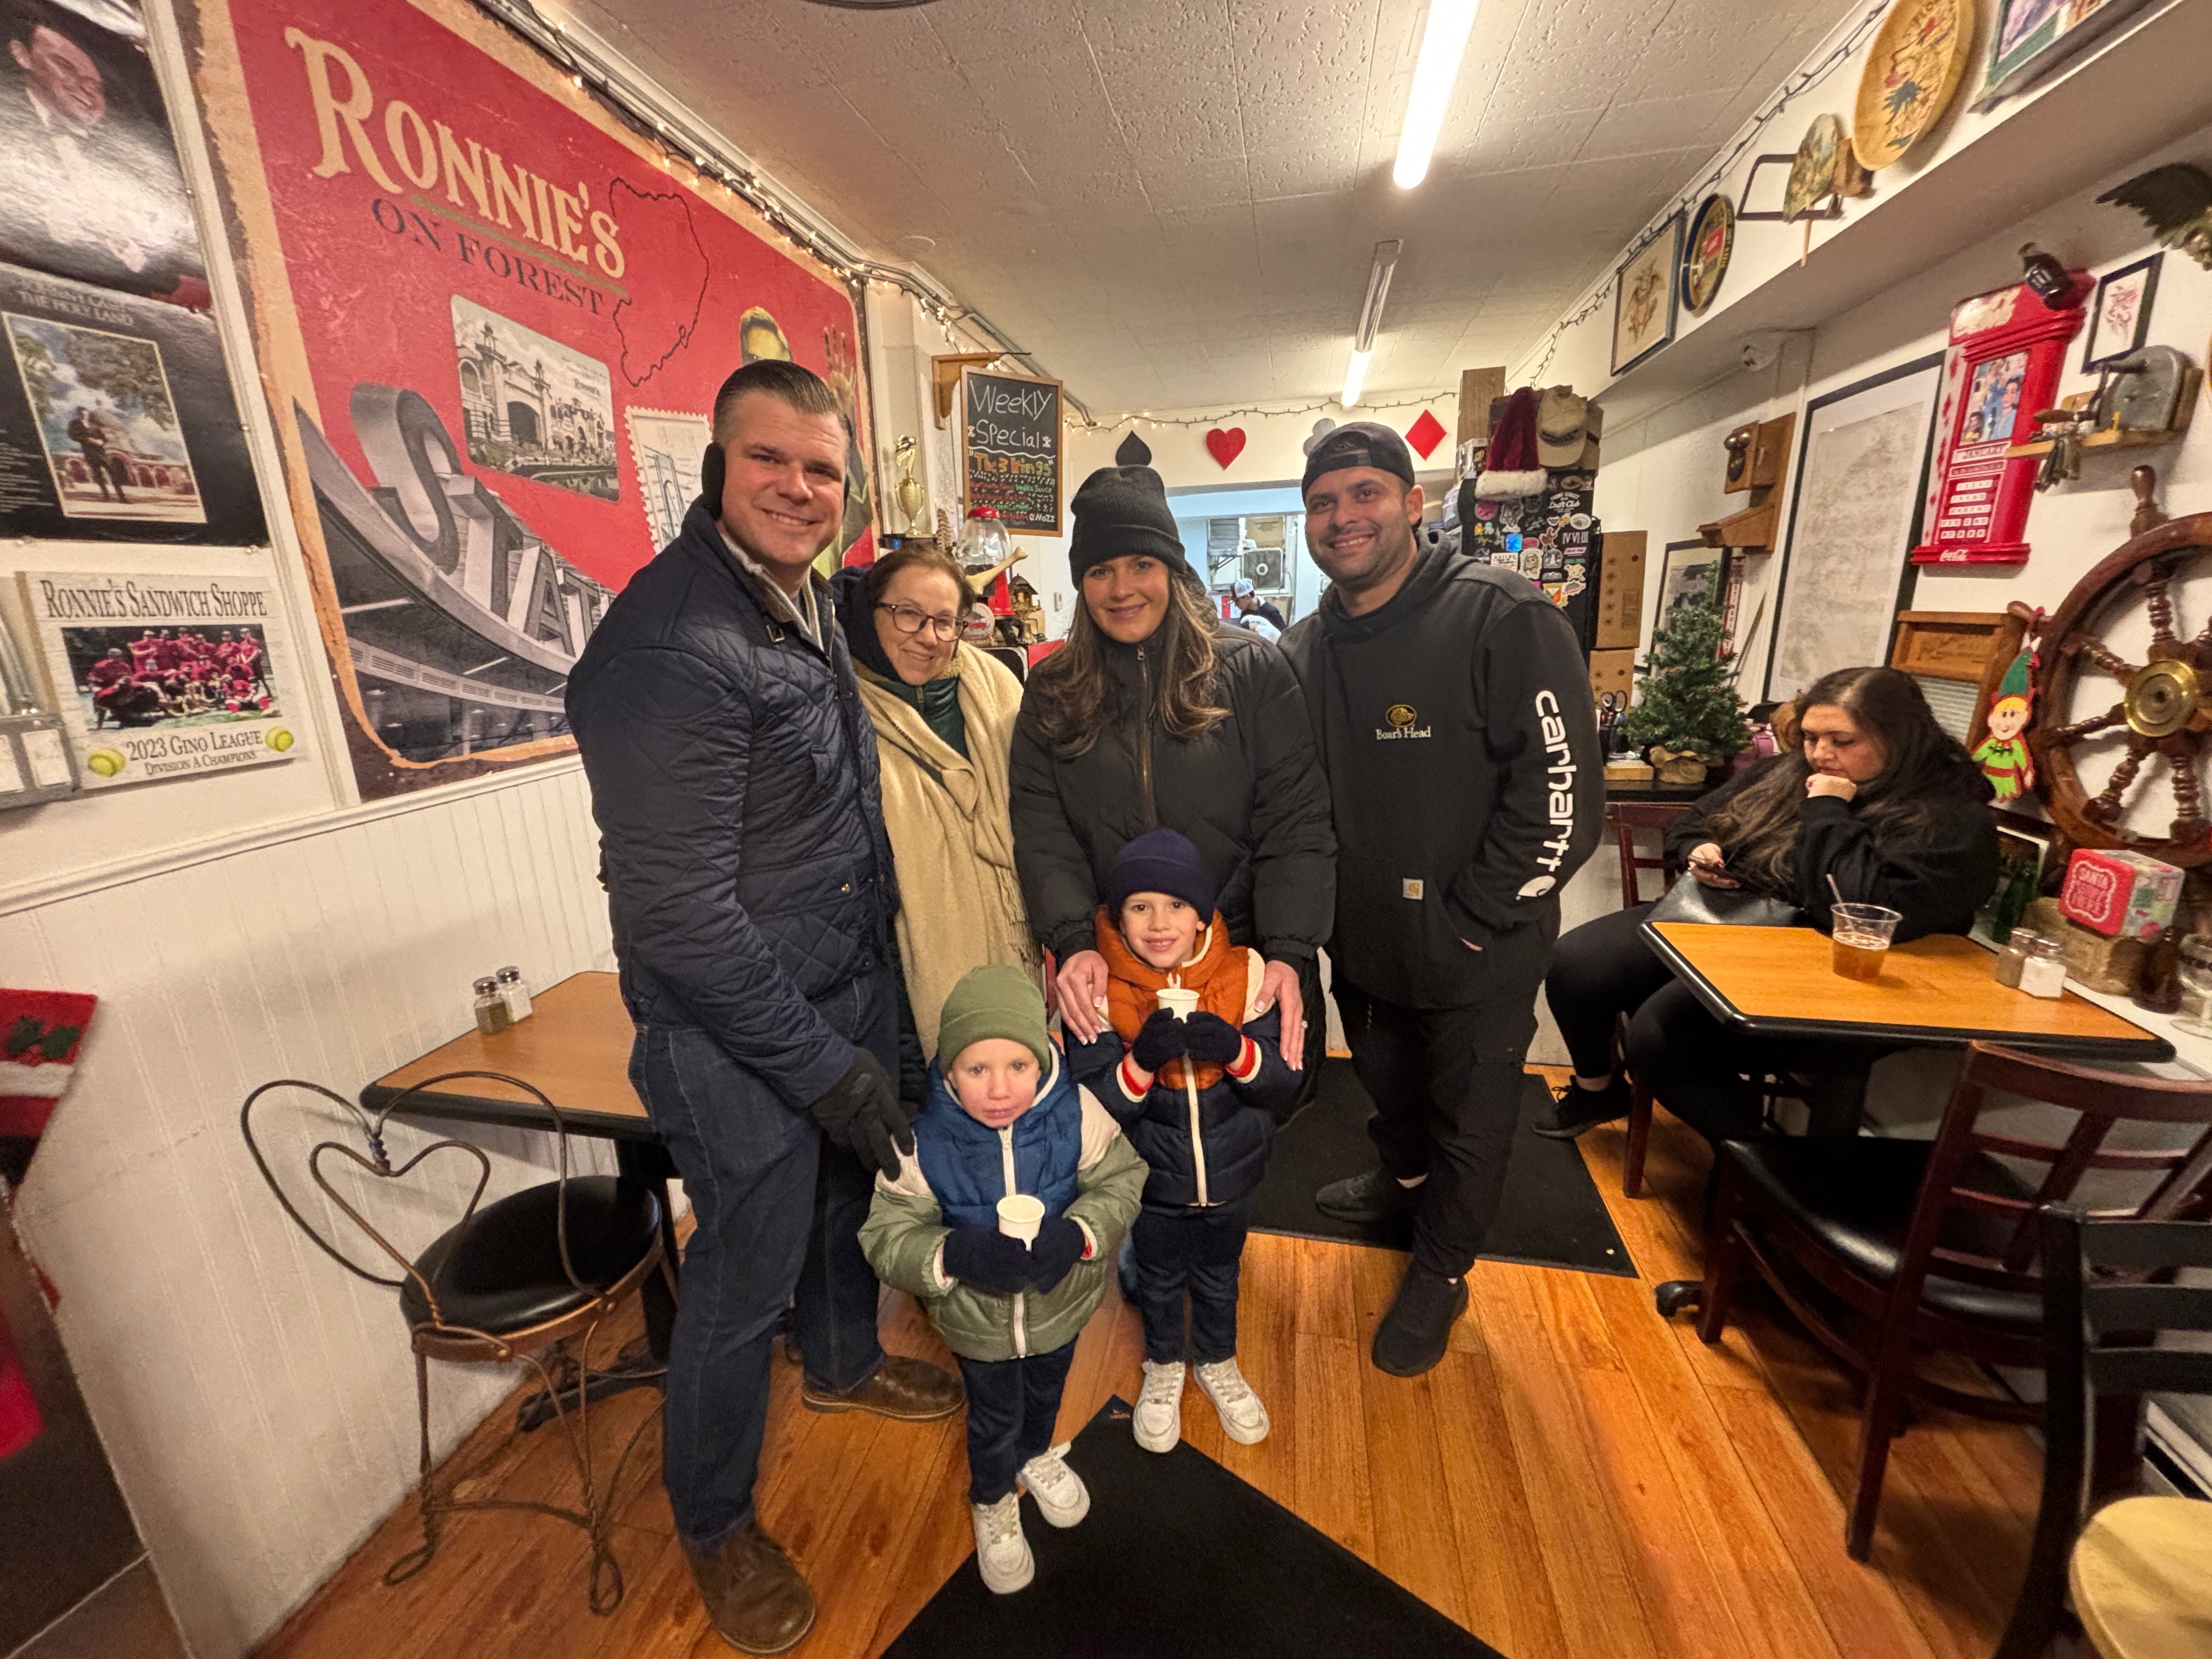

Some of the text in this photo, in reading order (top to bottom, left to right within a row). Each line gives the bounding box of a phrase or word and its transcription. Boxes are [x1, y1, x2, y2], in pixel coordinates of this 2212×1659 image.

[284, 26, 625, 278] RONNIE'S
[371, 198, 607, 315] ON FOREST
[969, 380, 1053, 421] Weekly
[998, 456, 1008, 473] 3
[349, 382, 612, 659] STAT
[40, 579, 268, 618] RONNIE'S SANDWICH SHOPPE
[126, 730, 263, 761] 2023 GINO LEAGUE
[1375, 725, 1432, 740] Boar's Head
[1535, 690, 1577, 873] carhartt
